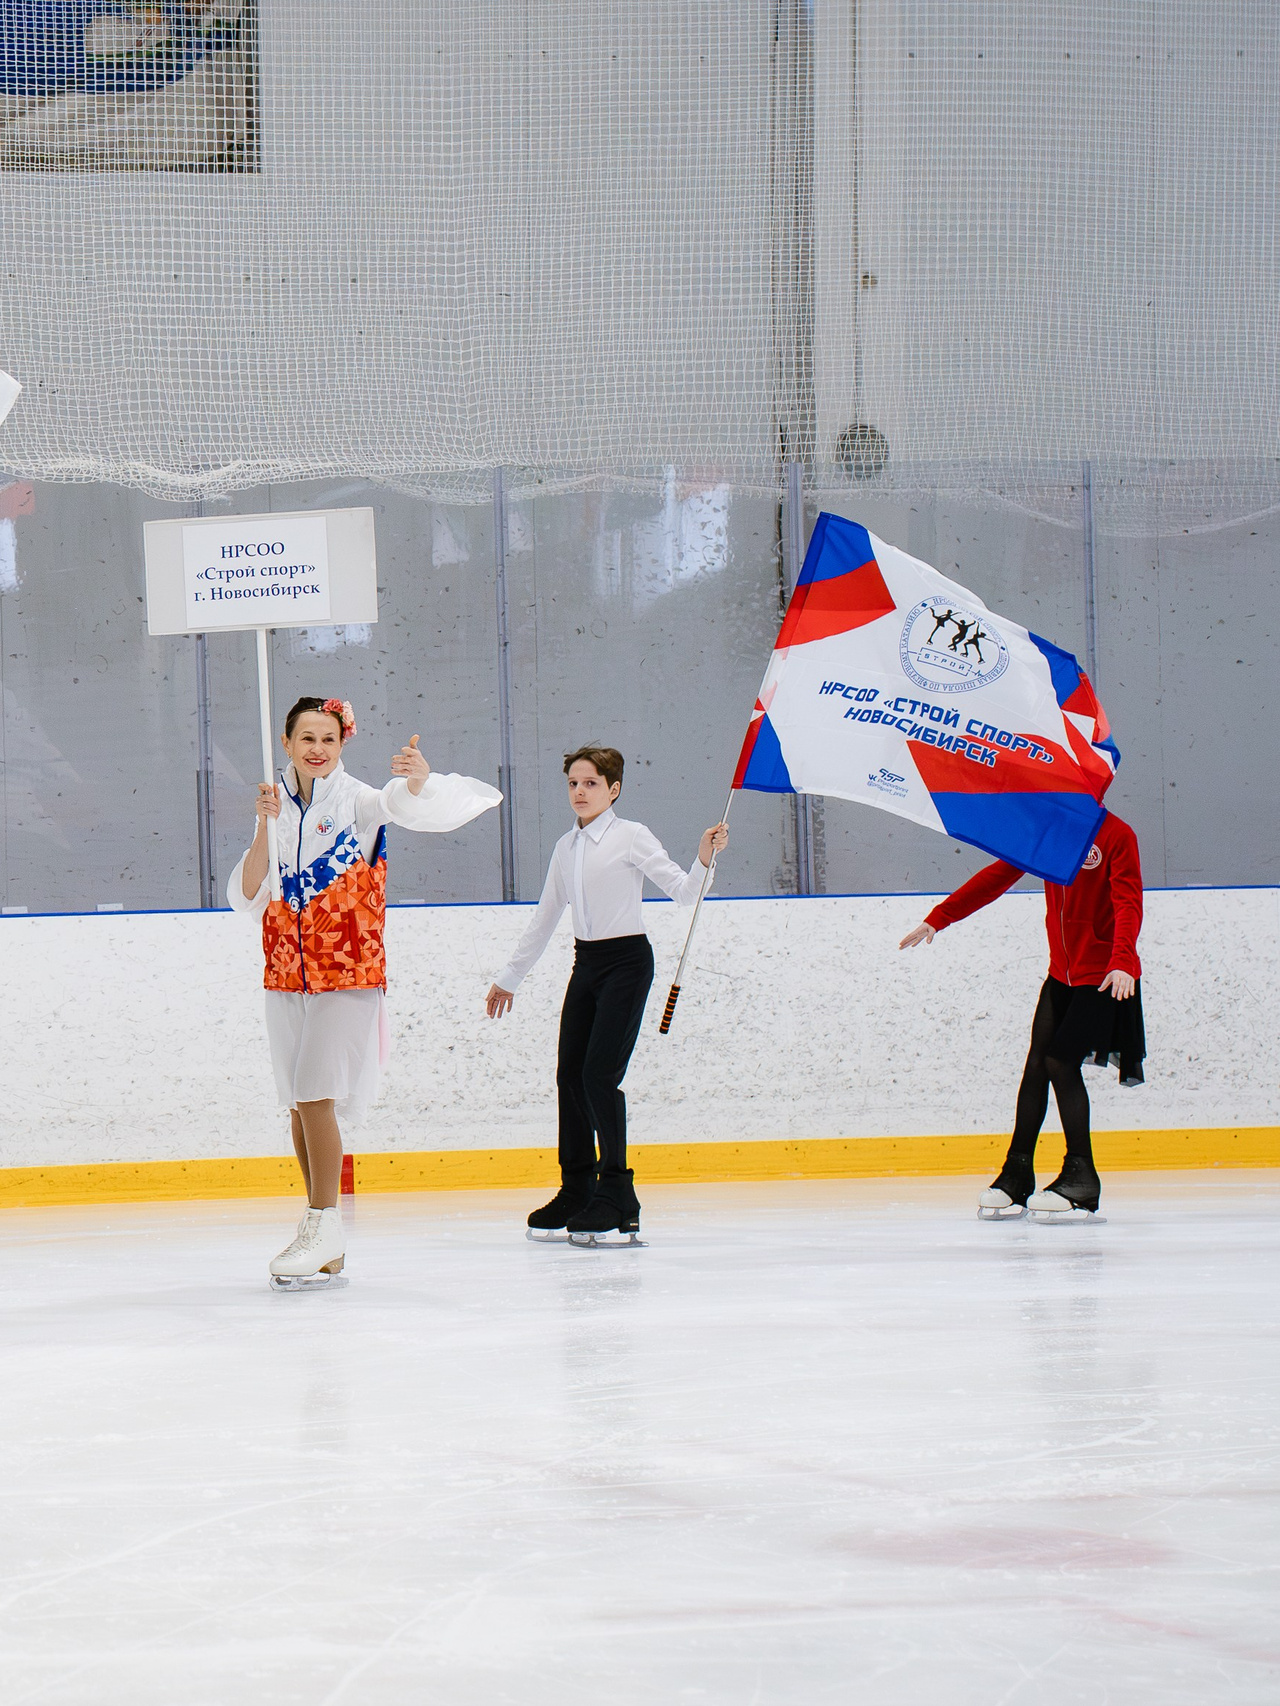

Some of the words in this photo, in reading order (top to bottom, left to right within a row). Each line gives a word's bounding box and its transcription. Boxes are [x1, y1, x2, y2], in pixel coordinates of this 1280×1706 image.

[220, 541, 286, 560] НРСОО
[195, 565, 256, 584] «Строй
[260, 563, 316, 581] спорт»
[194, 590, 206, 602] г.
[210, 583, 321, 601] Новосибирск
[819, 680, 880, 702] НРСОО
[883, 697, 961, 729] «СТРОЙ
[965, 718, 1055, 764] СПОРТ»
[843, 706, 1000, 768] НОВОСИБИРСК
